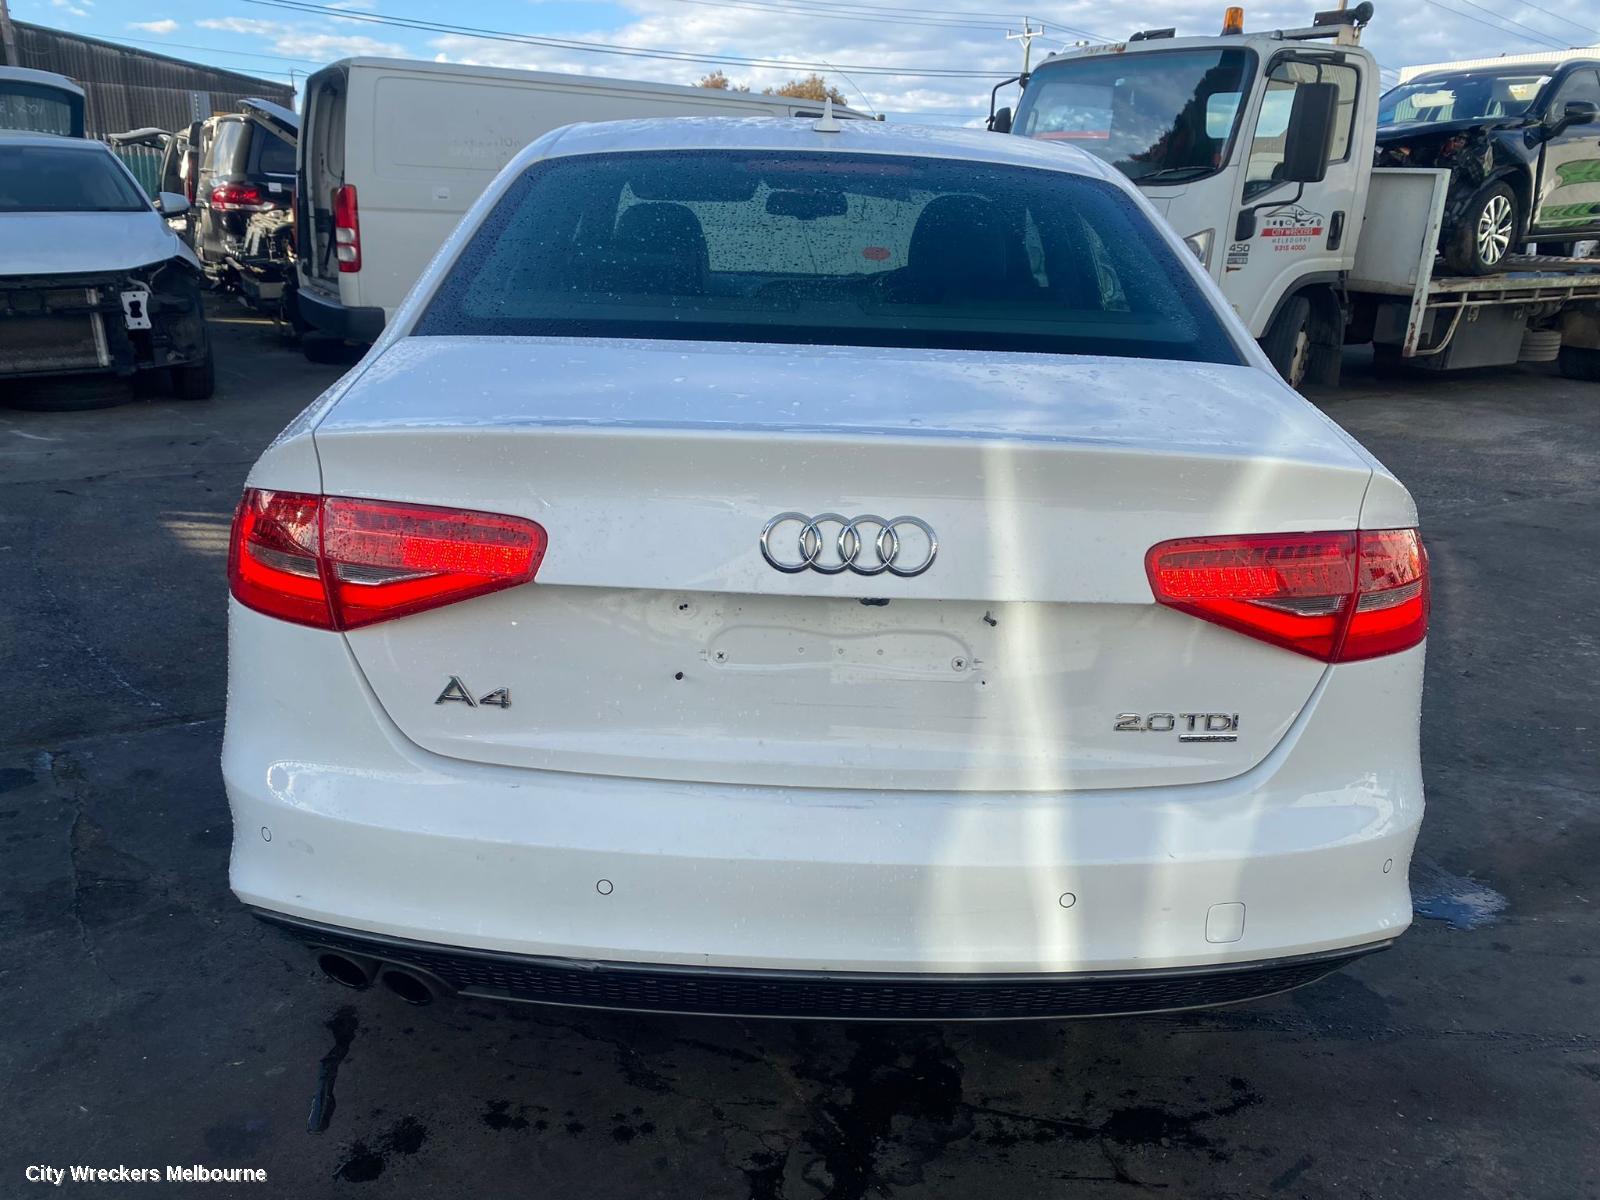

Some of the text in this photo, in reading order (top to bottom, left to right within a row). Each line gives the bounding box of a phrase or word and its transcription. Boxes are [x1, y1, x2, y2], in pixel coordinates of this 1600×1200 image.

[1286, 227, 1313, 236] WRECKERS
[1229, 244, 1250, 252] 450
[434, 675, 511, 709] A4
[1179, 712, 1240, 732] TDI
